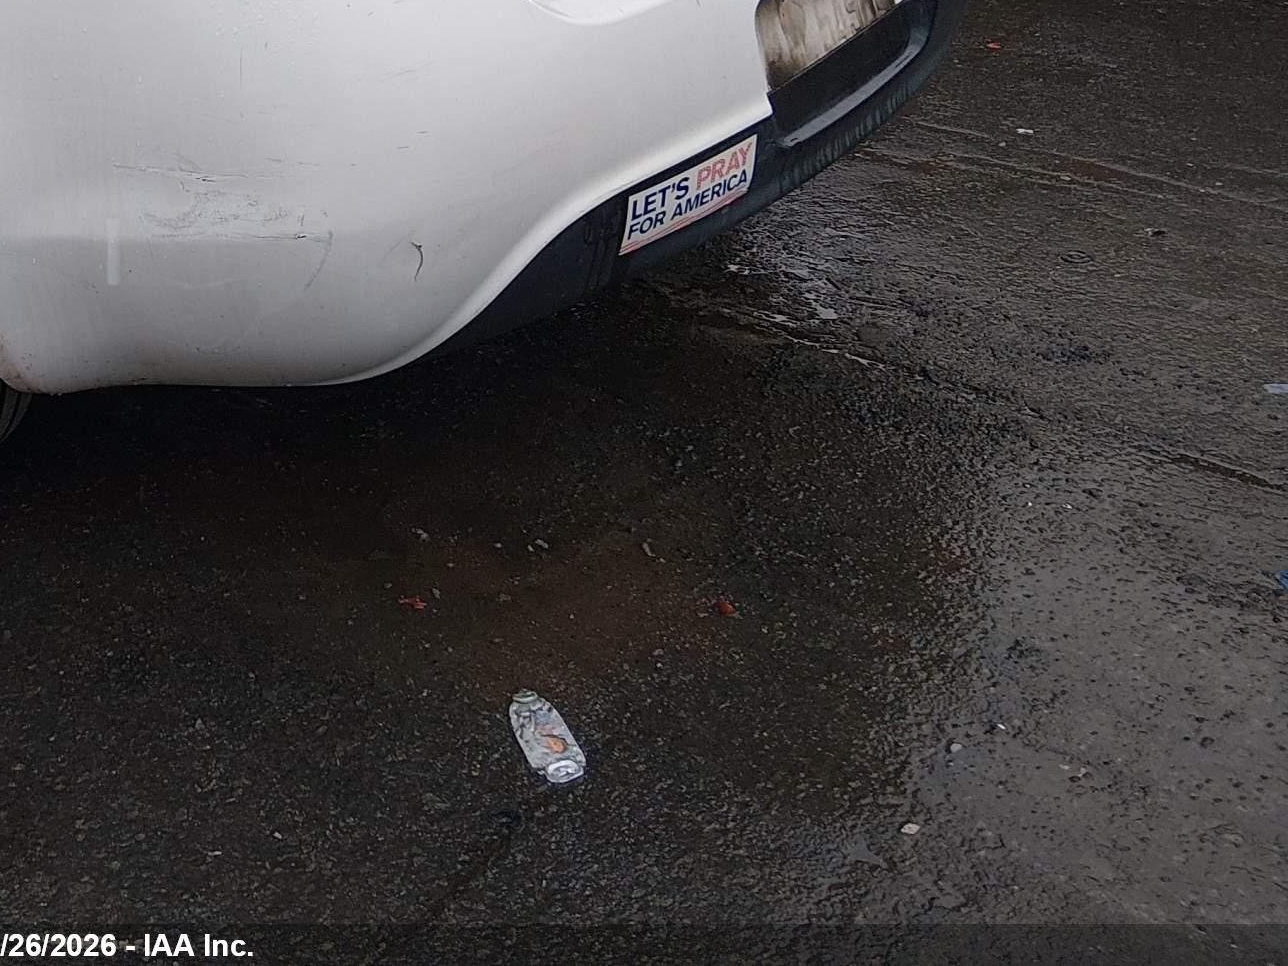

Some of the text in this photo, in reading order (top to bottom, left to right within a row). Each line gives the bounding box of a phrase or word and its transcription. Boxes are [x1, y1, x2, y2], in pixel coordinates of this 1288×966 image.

[627, 169, 747, 240] FOR AMERICA
[631, 142, 752, 222] LET'S PRAY
